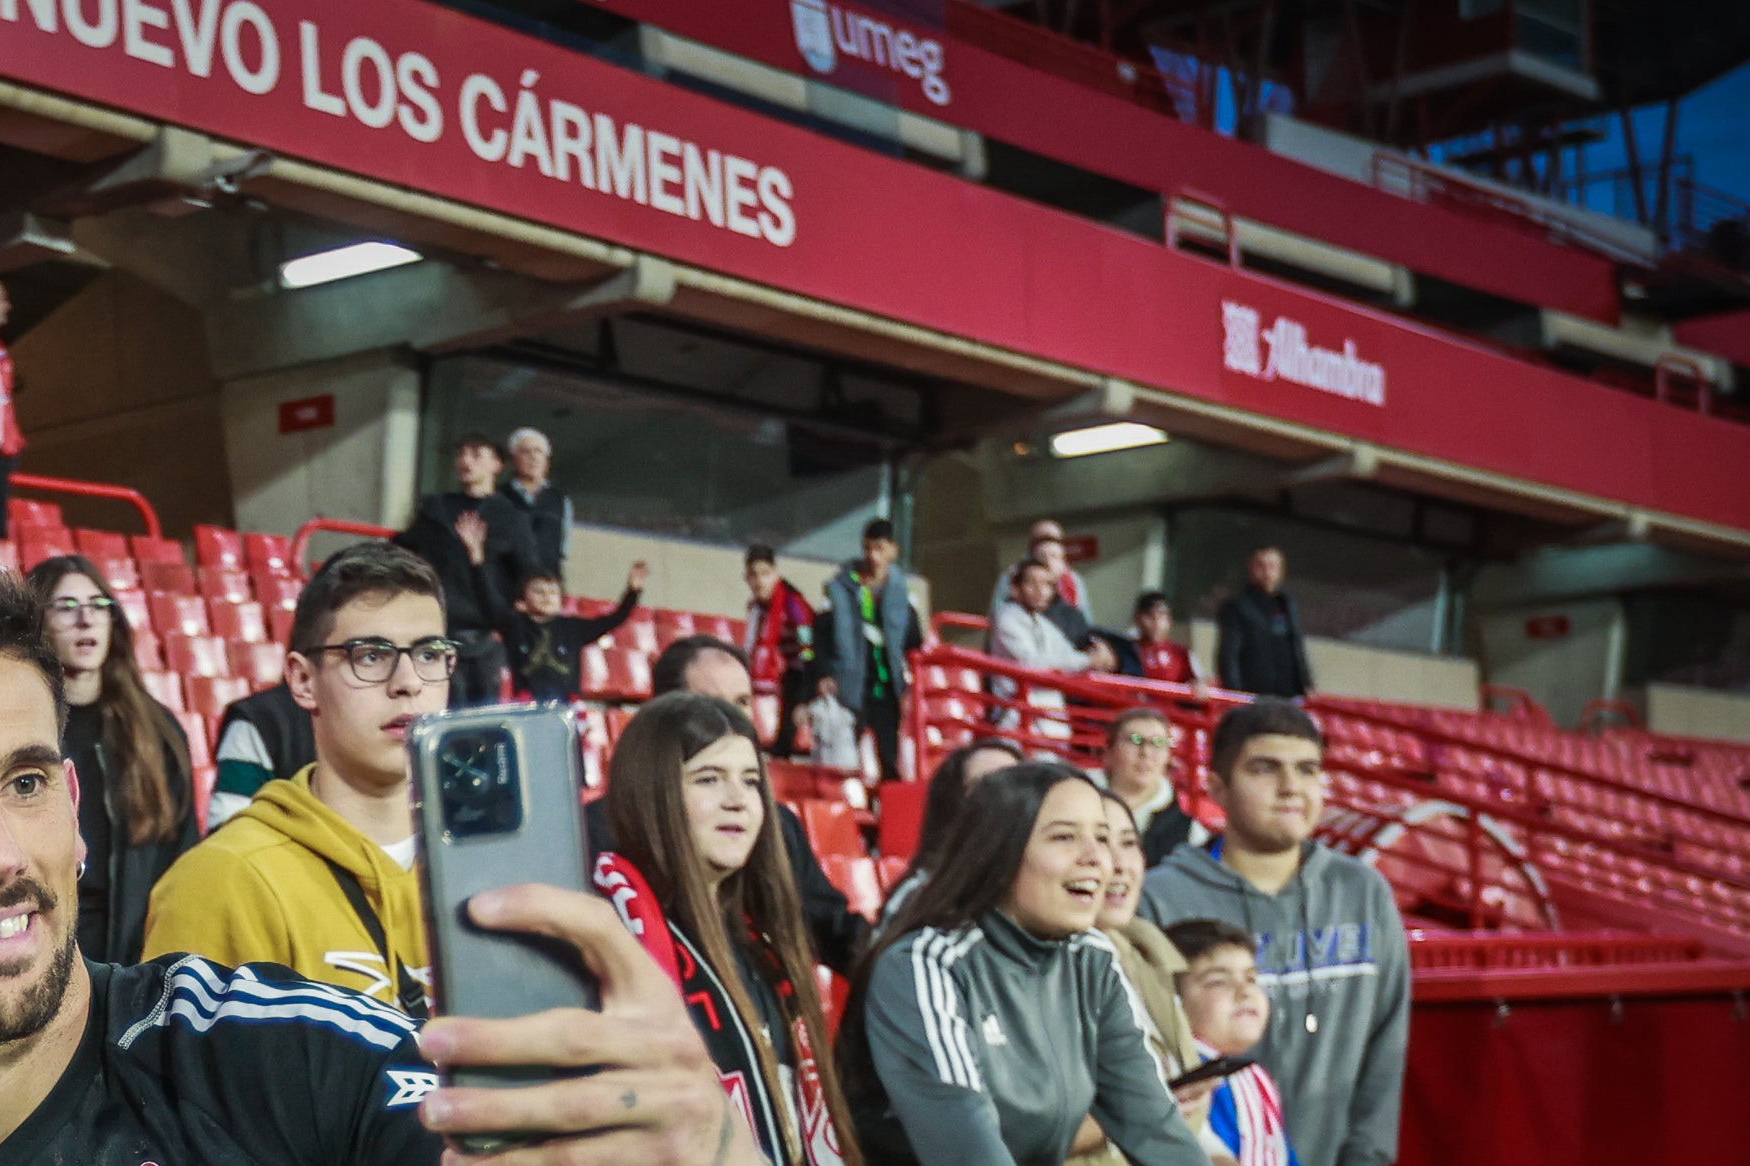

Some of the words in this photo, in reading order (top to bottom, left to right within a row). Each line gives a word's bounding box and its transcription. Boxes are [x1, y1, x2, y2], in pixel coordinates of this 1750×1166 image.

[299, 20, 444, 143] LOS
[458, 68, 796, 247] CÁRMENES
[831, 6, 951, 106] umeg
